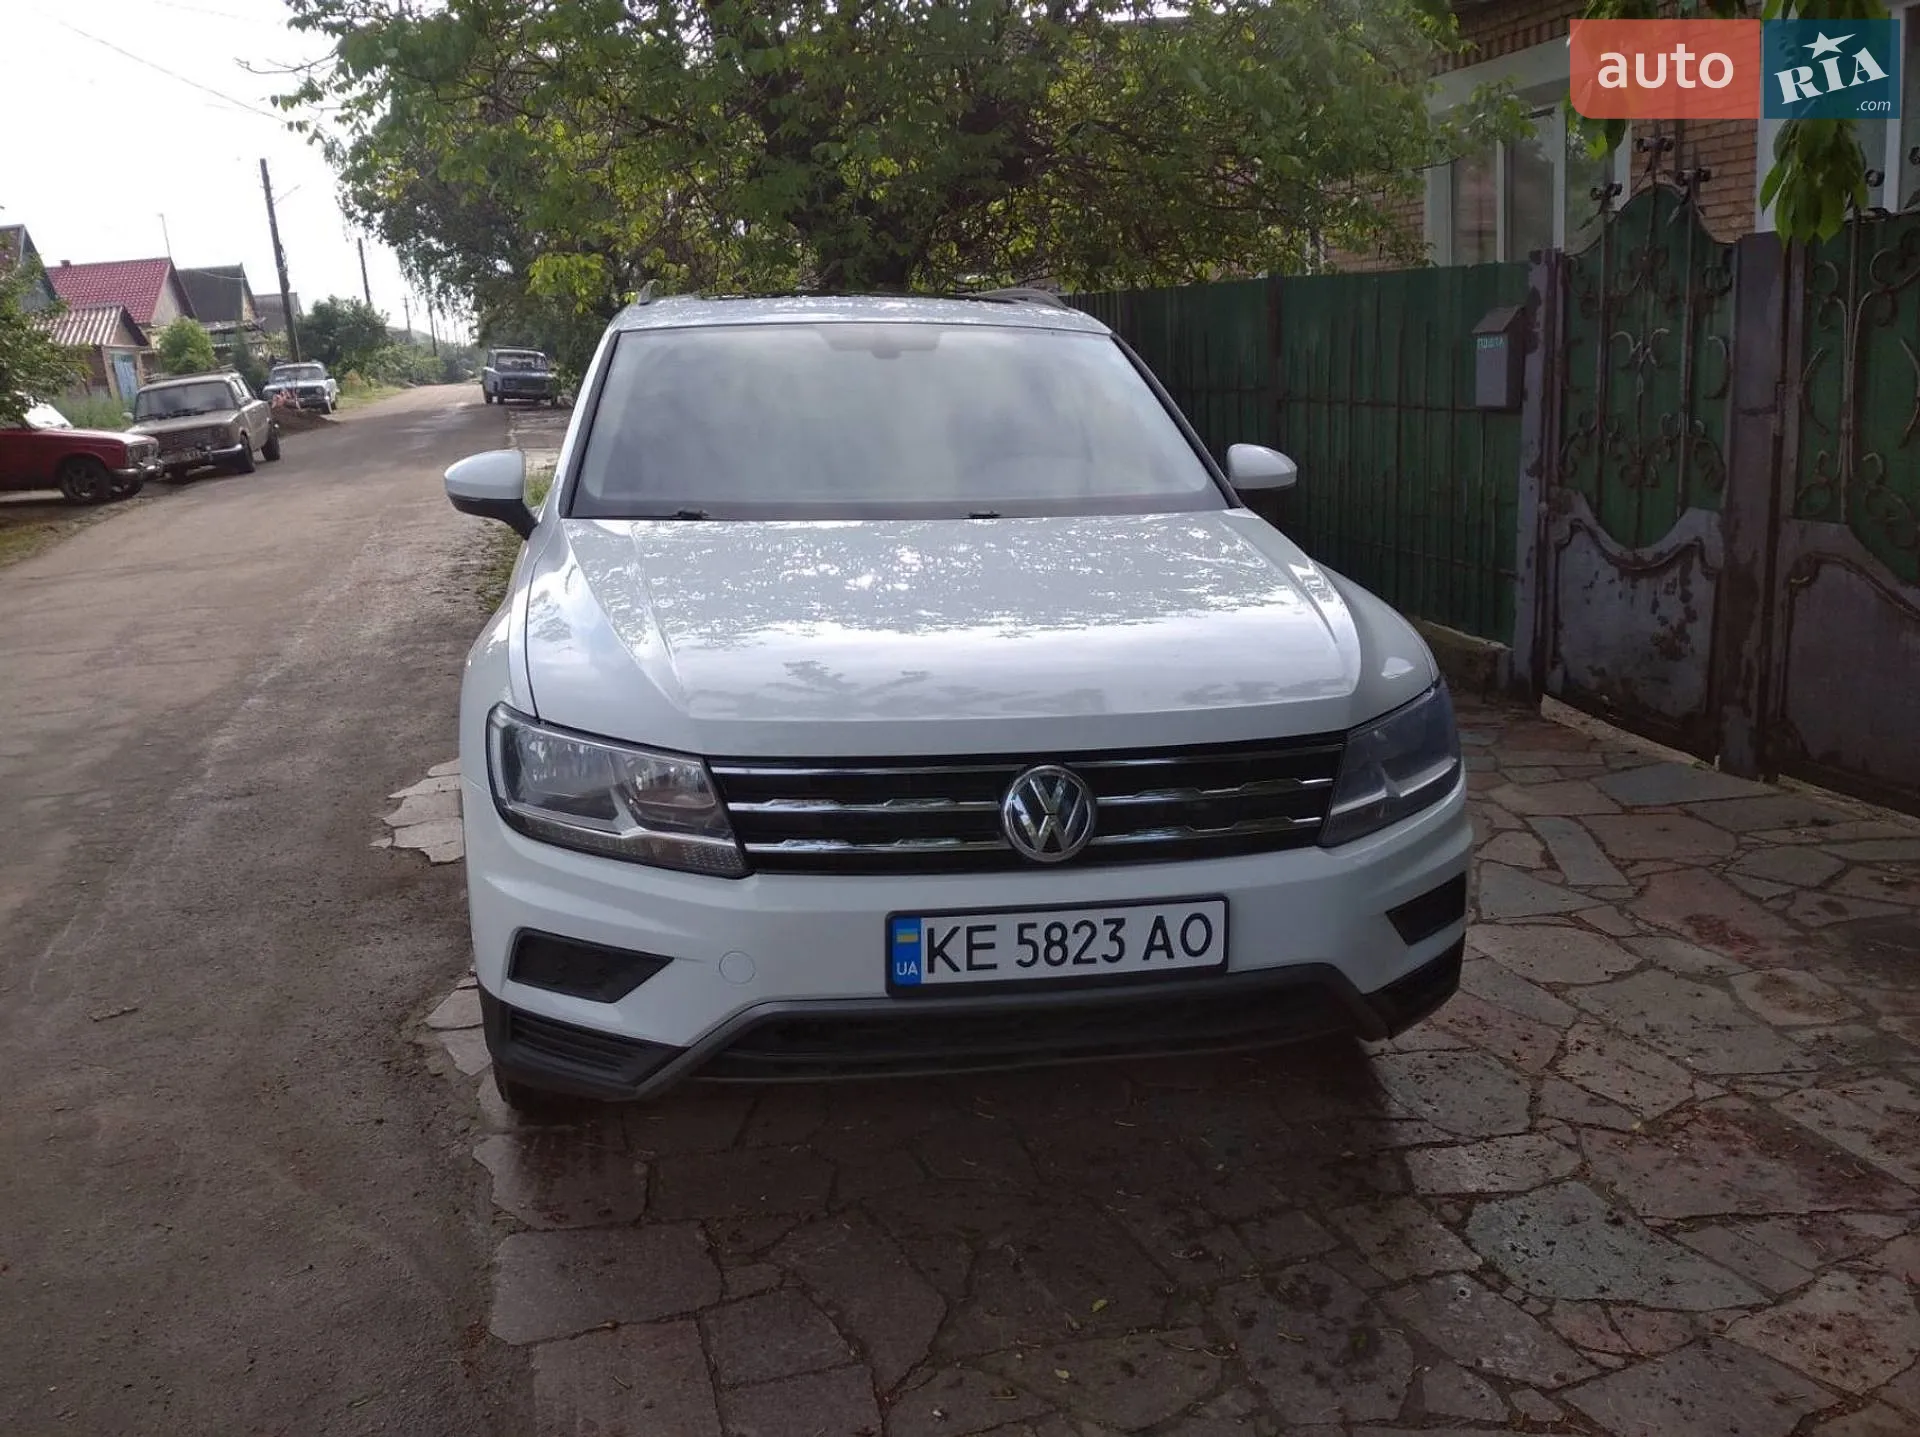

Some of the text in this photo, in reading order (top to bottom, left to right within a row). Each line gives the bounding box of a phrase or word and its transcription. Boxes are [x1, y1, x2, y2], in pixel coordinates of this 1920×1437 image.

[926, 912, 1213, 974] KE 5823 AO
[896, 961, 918, 976] UA
